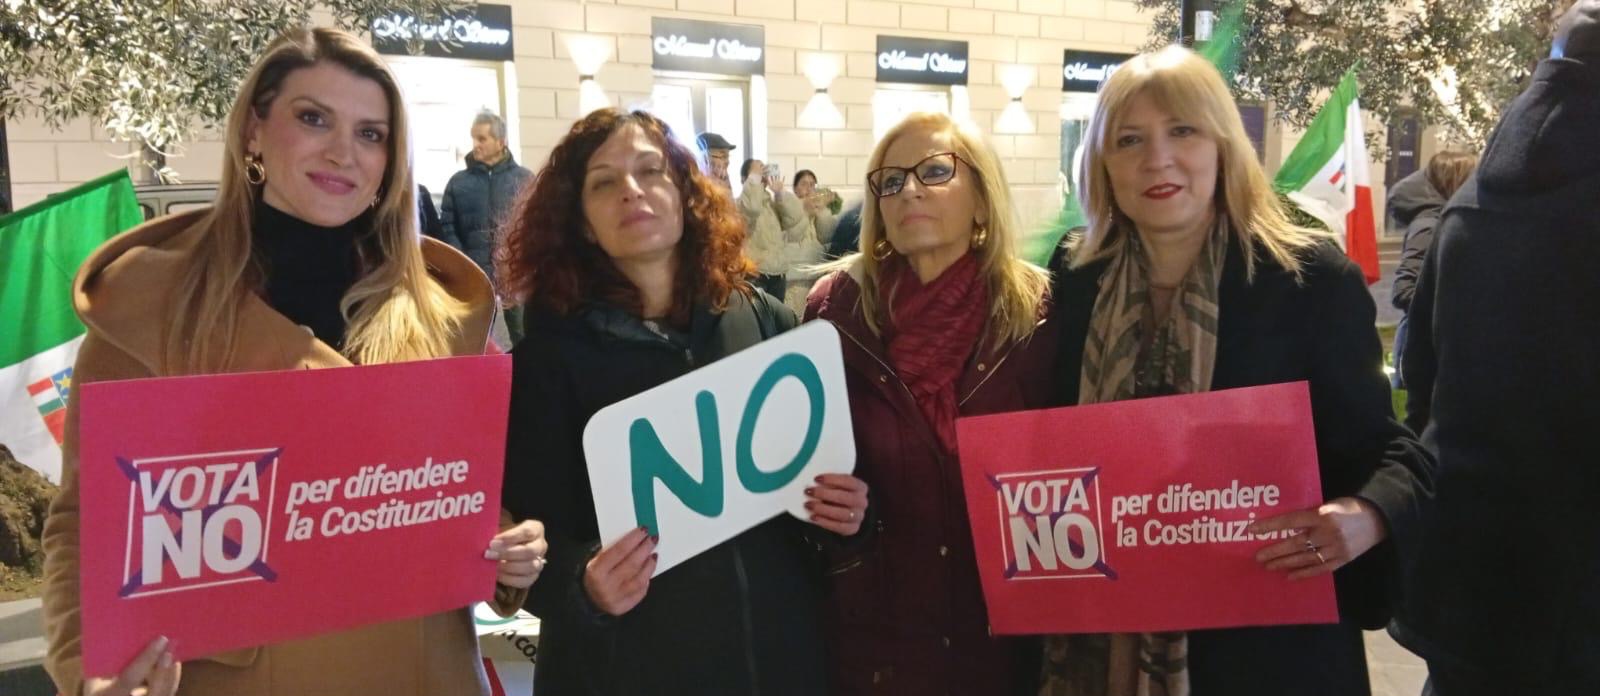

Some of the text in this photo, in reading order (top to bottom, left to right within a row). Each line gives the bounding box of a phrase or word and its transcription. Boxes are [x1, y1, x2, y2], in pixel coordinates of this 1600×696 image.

[629, 352, 825, 538] NO
[139, 461, 260, 512] VOTA
[285, 456, 469, 514] per difendere
[1000, 477, 1090, 515] VOTA
[1111, 480, 1280, 523] per difendere
[285, 490, 486, 543] la Costituzione
[1009, 512, 1099, 571] NO
[1116, 519, 1138, 548] la
[142, 504, 263, 585] NO
